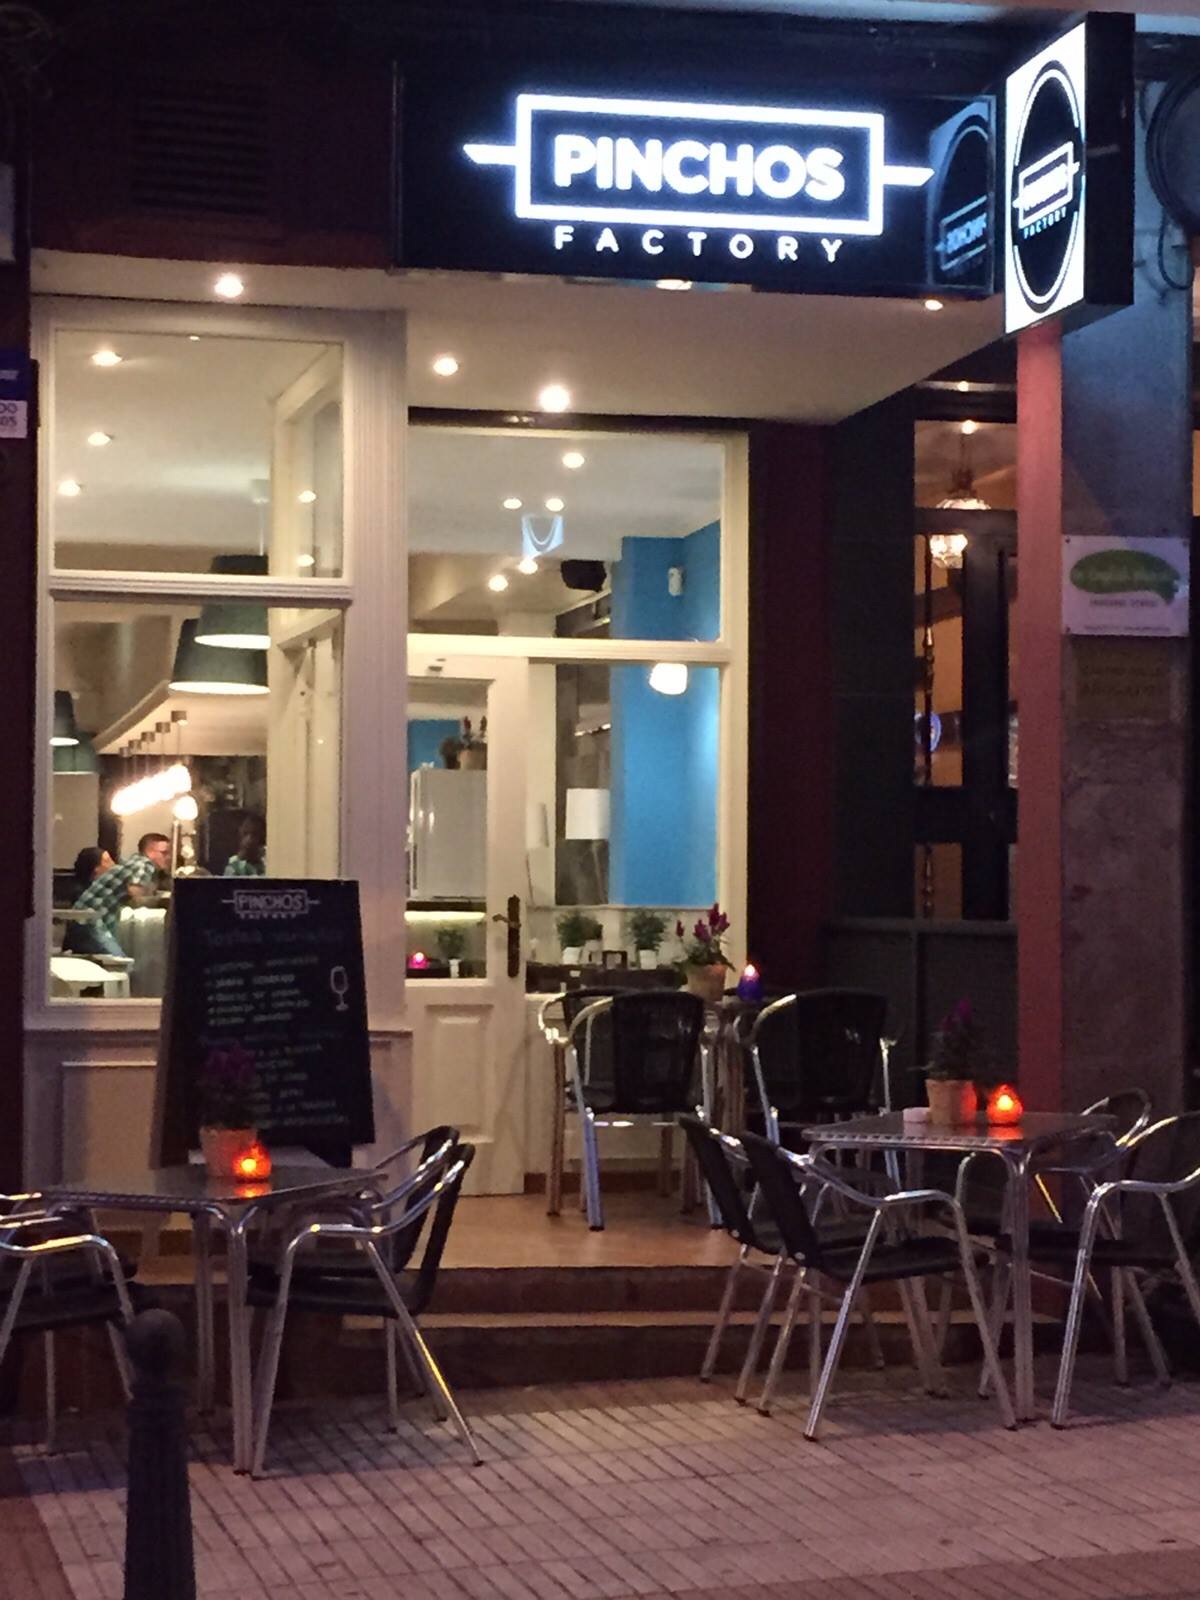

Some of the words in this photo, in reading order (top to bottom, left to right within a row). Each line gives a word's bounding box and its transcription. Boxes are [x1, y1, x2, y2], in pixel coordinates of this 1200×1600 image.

[554, 133, 845, 201] PINCHOS
[554, 225, 843, 262] FACTORY
[238, 894, 303, 910] PINCHOS
